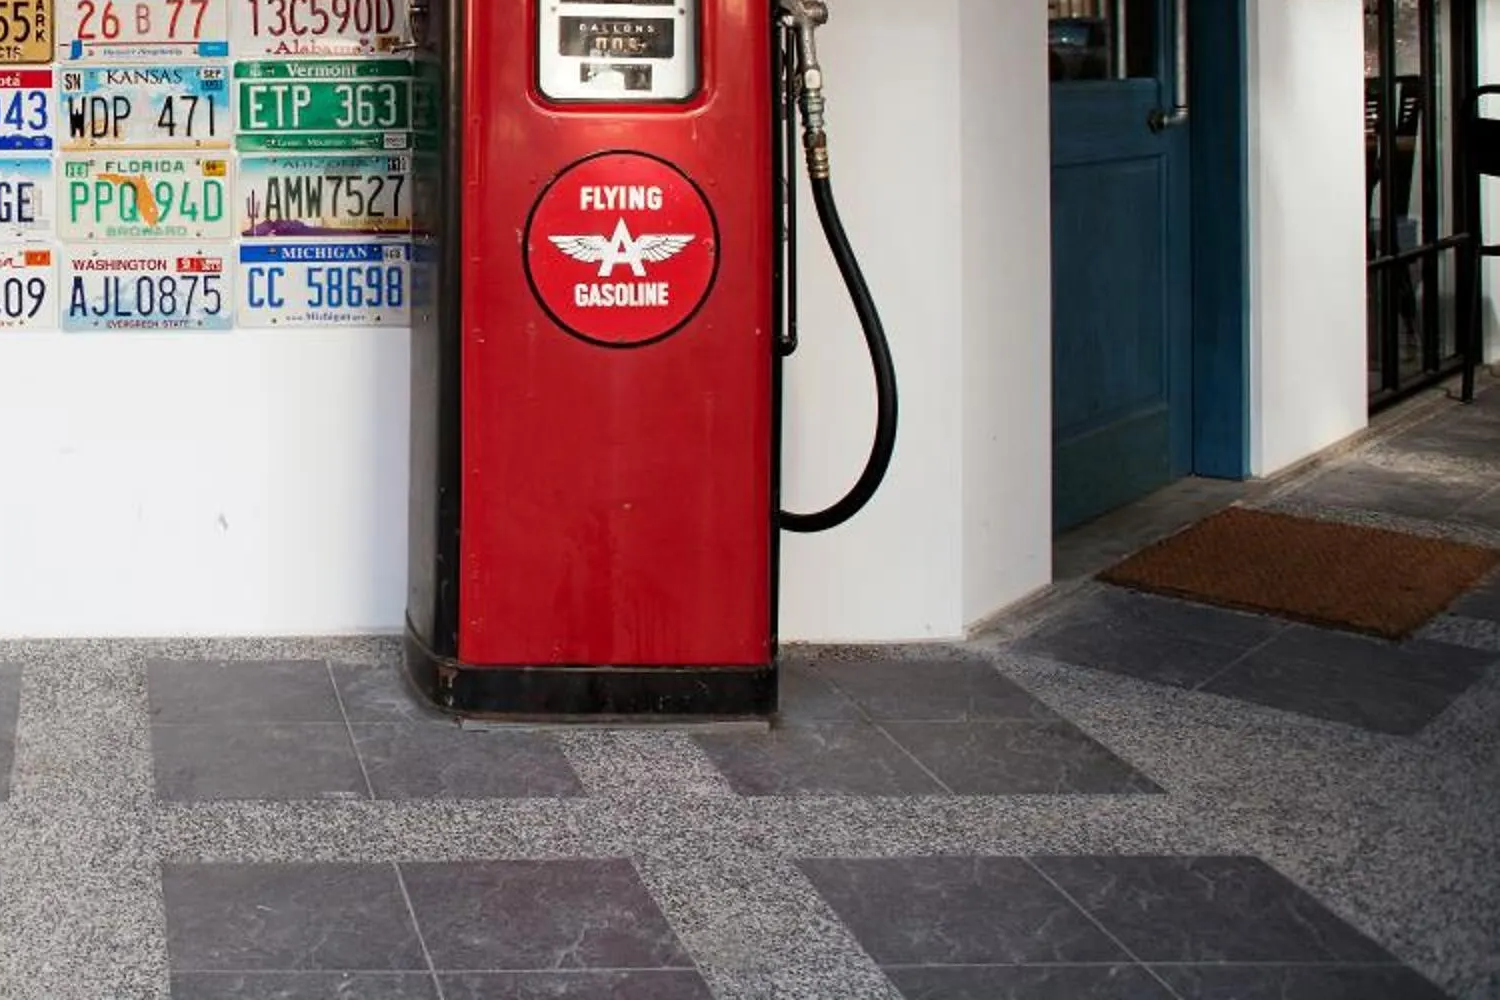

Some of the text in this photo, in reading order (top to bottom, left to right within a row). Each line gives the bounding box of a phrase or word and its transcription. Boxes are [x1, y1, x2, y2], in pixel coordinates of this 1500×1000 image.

[77, 0, 119, 39] 26
[136, 4, 149, 34] B
[106, 69, 182, 84] KANSAS
[285, 63, 357, 76] Vermont
[69, 94, 215, 138] WDP 471
[250, 84, 397, 129] ETP 363
[105, 161, 185, 173] FLORIDA
[70, 181, 139, 222] PPQ
[266, 176, 405, 220] AMW7527
[580, 185, 663, 210] FLYING
[106, 225, 189, 237] BROWARD
[71, 258, 168, 271] WASHINGTON
[281, 247, 368, 259] MICHIGAN
[69, 275, 221, 317] AJL0875
[248, 266, 403, 308] CC 58698
[575, 282, 668, 307] GASOLINE
